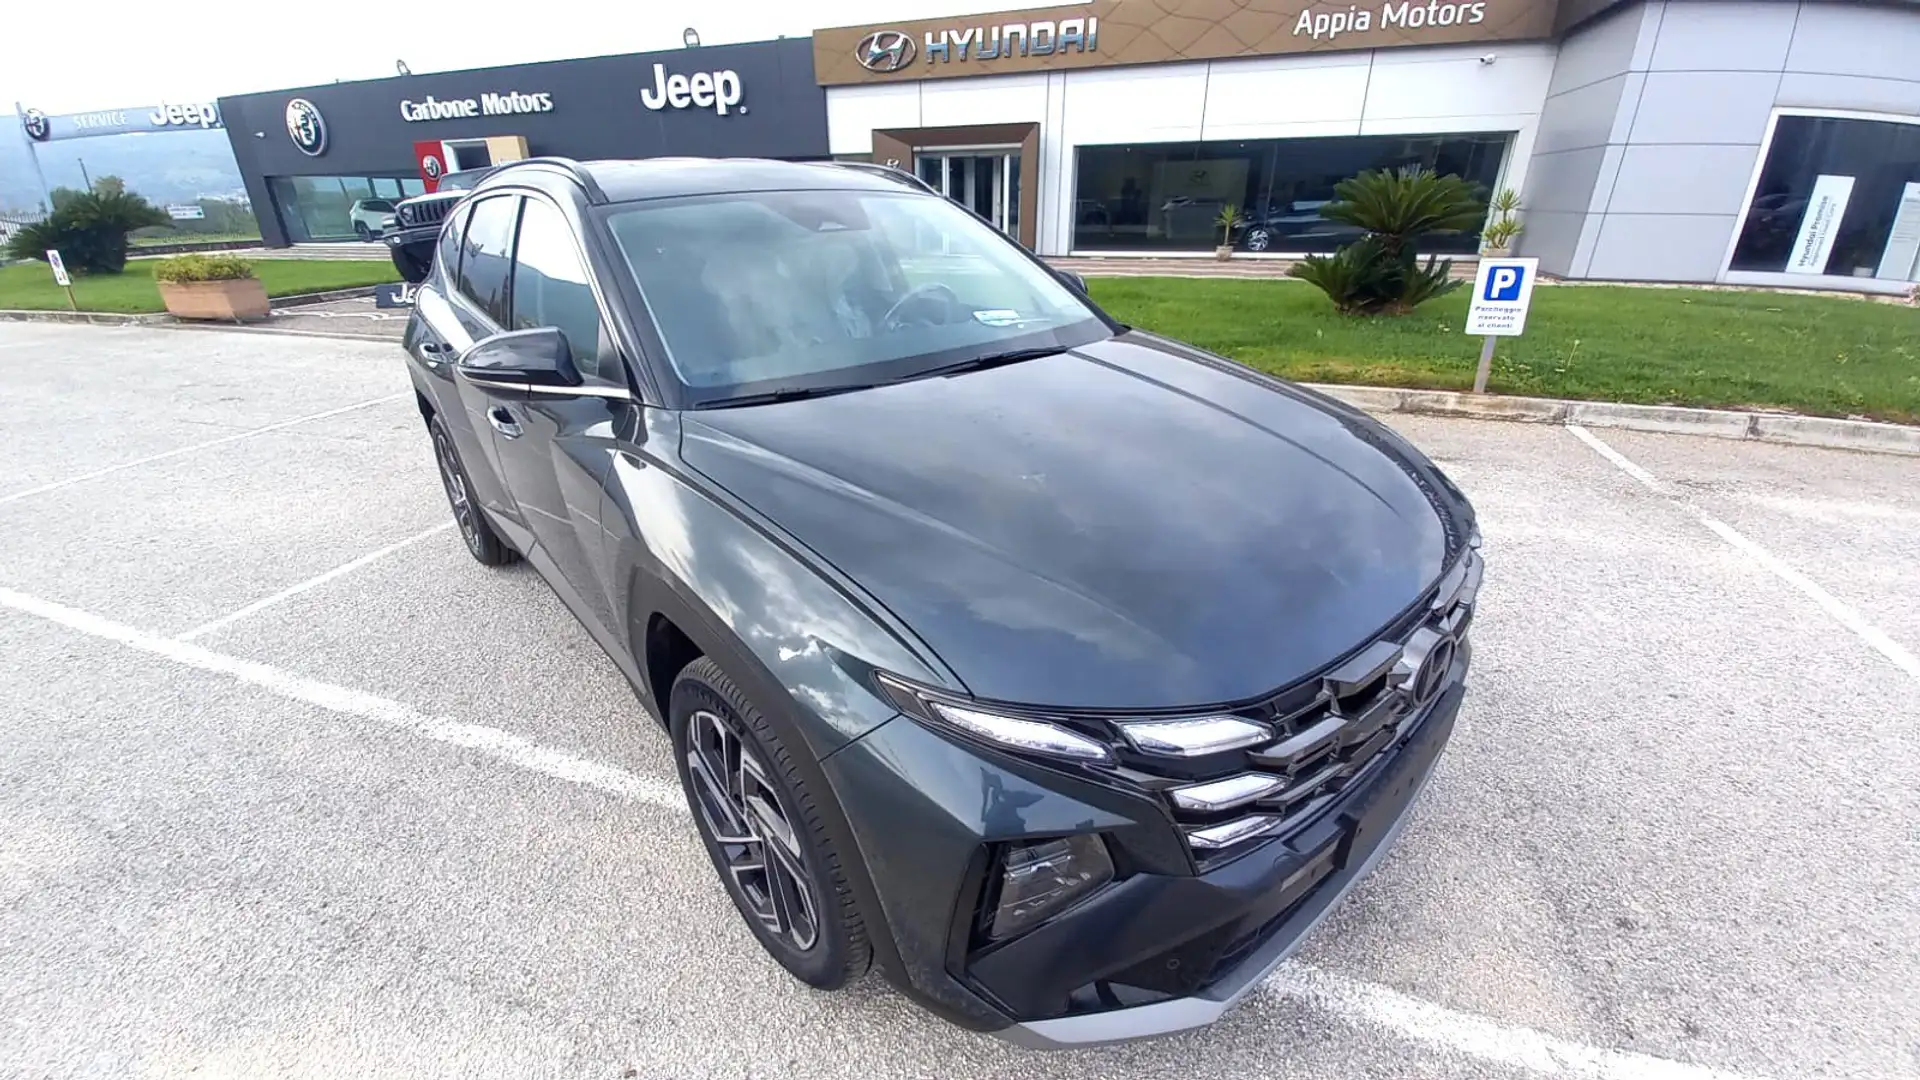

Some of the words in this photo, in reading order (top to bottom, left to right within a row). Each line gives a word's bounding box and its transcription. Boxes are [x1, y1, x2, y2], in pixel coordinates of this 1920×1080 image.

[1293, 5, 1371, 40] Appia
[1380, 0, 1486, 30] Motors
[925, 17, 1098, 64] HYUNDAI
[641, 63, 741, 115] Jeep
[74, 110, 128, 129] SERVICE
[150, 102, 217, 129] Jeep
[401, 96, 479, 122] Carbone
[480, 91, 553, 116] Motors
[1798, 231, 1816, 266] Hyundai
[1490, 268, 1516, 299] P
